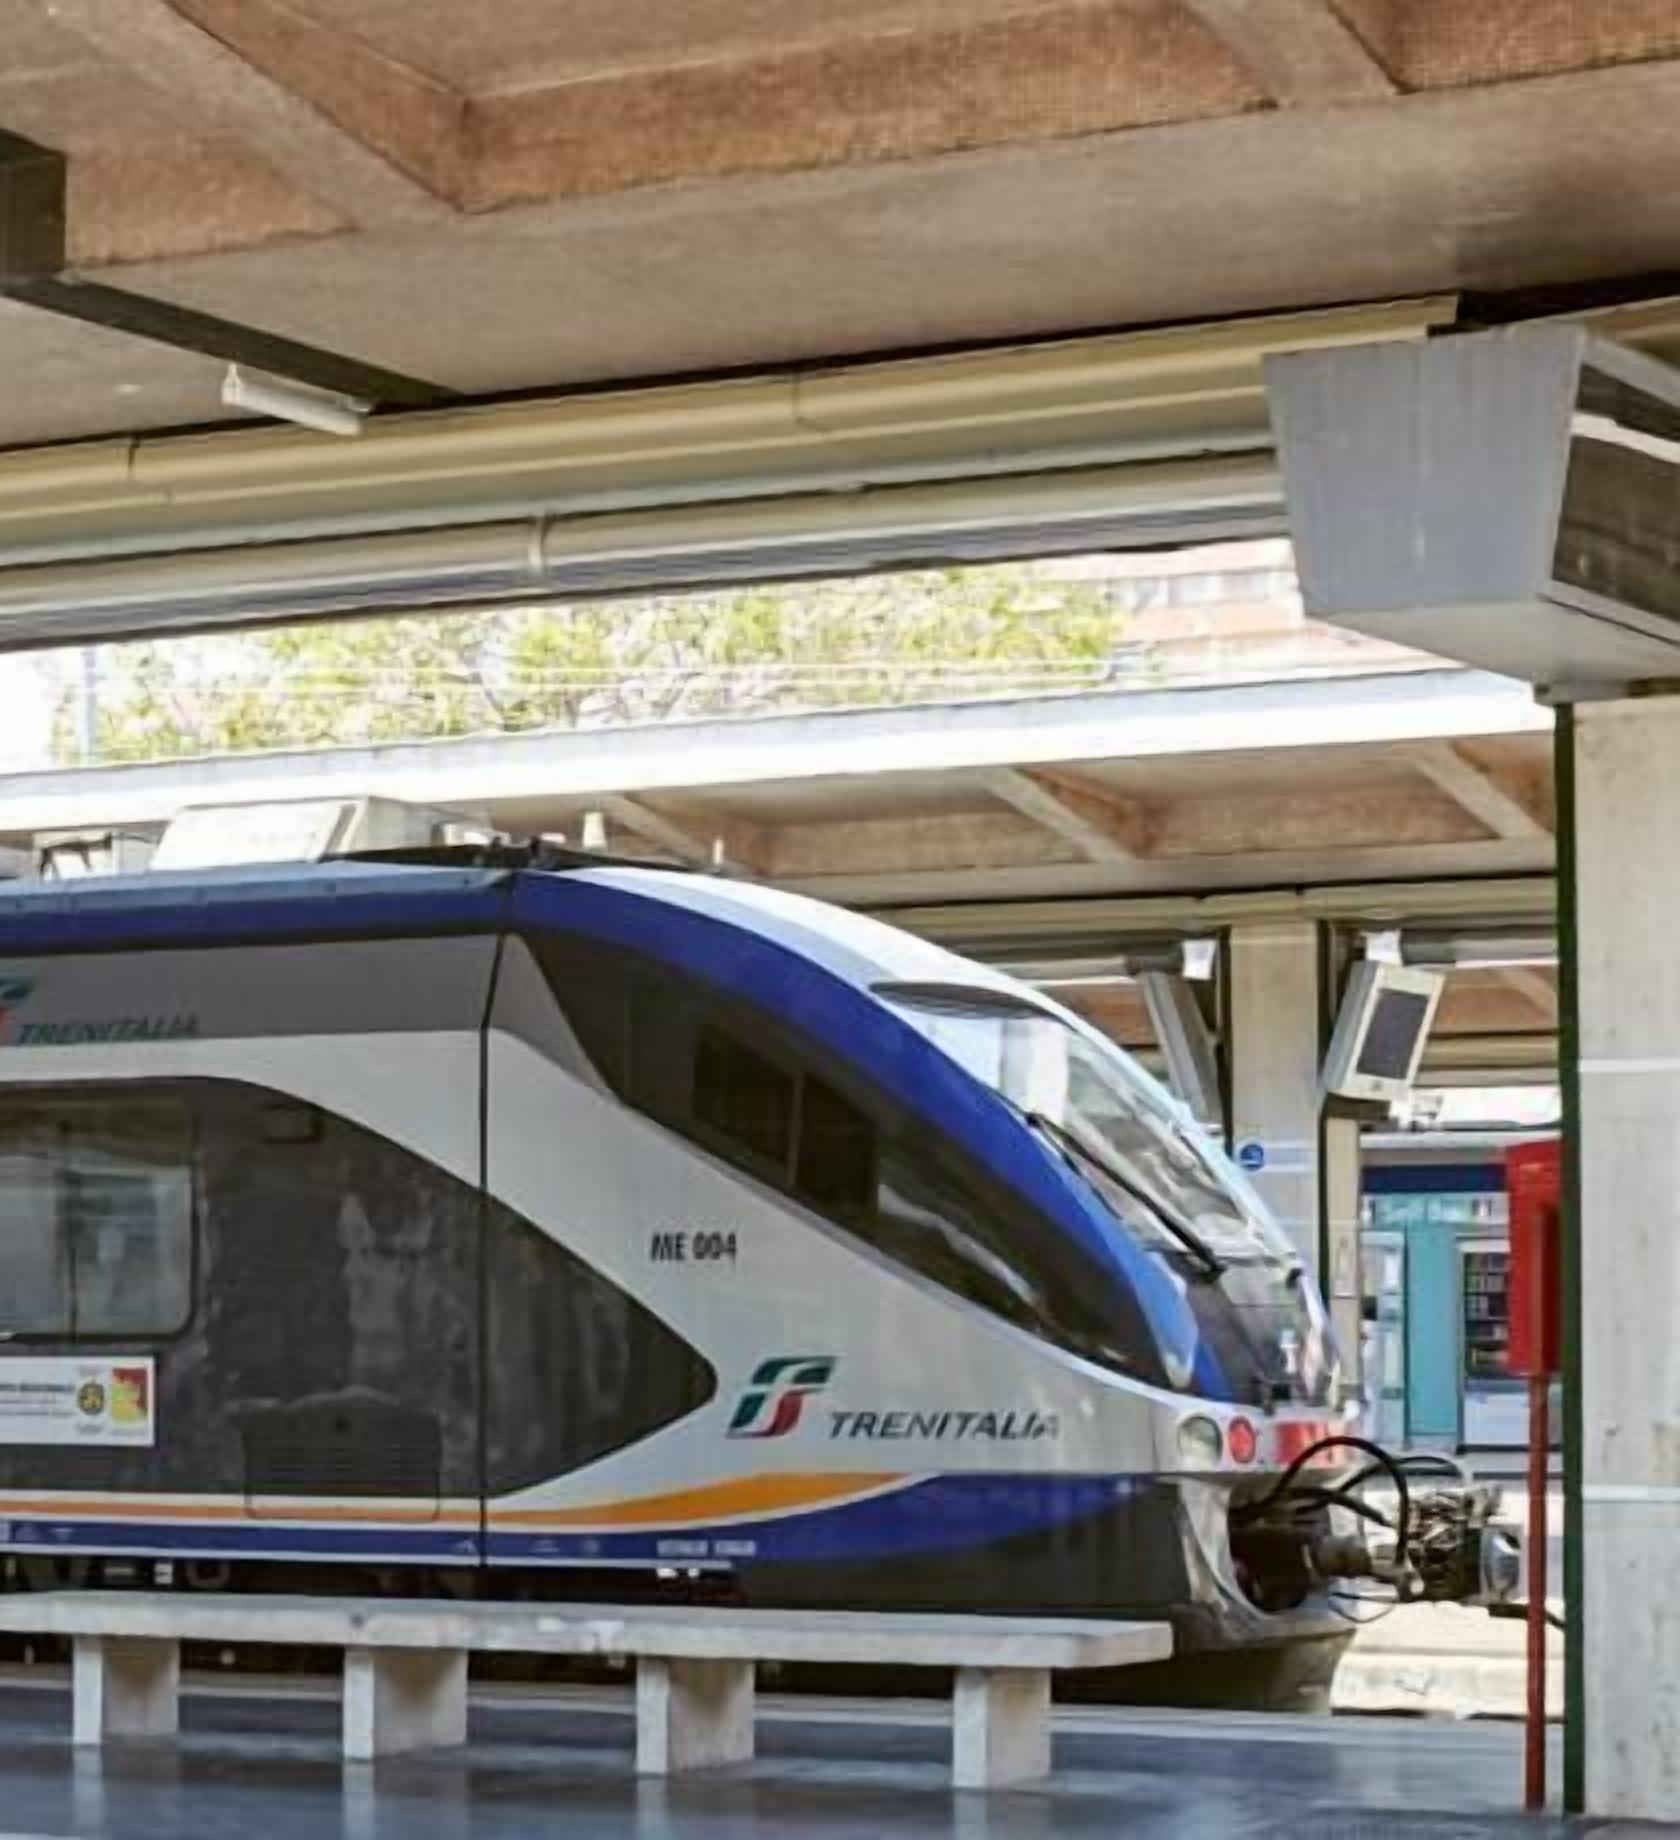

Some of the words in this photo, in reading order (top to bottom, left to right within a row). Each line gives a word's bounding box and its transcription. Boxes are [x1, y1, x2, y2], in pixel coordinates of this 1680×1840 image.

[20, 1015, 199, 1044] TRENITALIA
[651, 1232, 686, 1260] ME
[692, 1231, 737, 1261] 004
[829, 1411, 1060, 1439] TRENITALIA
